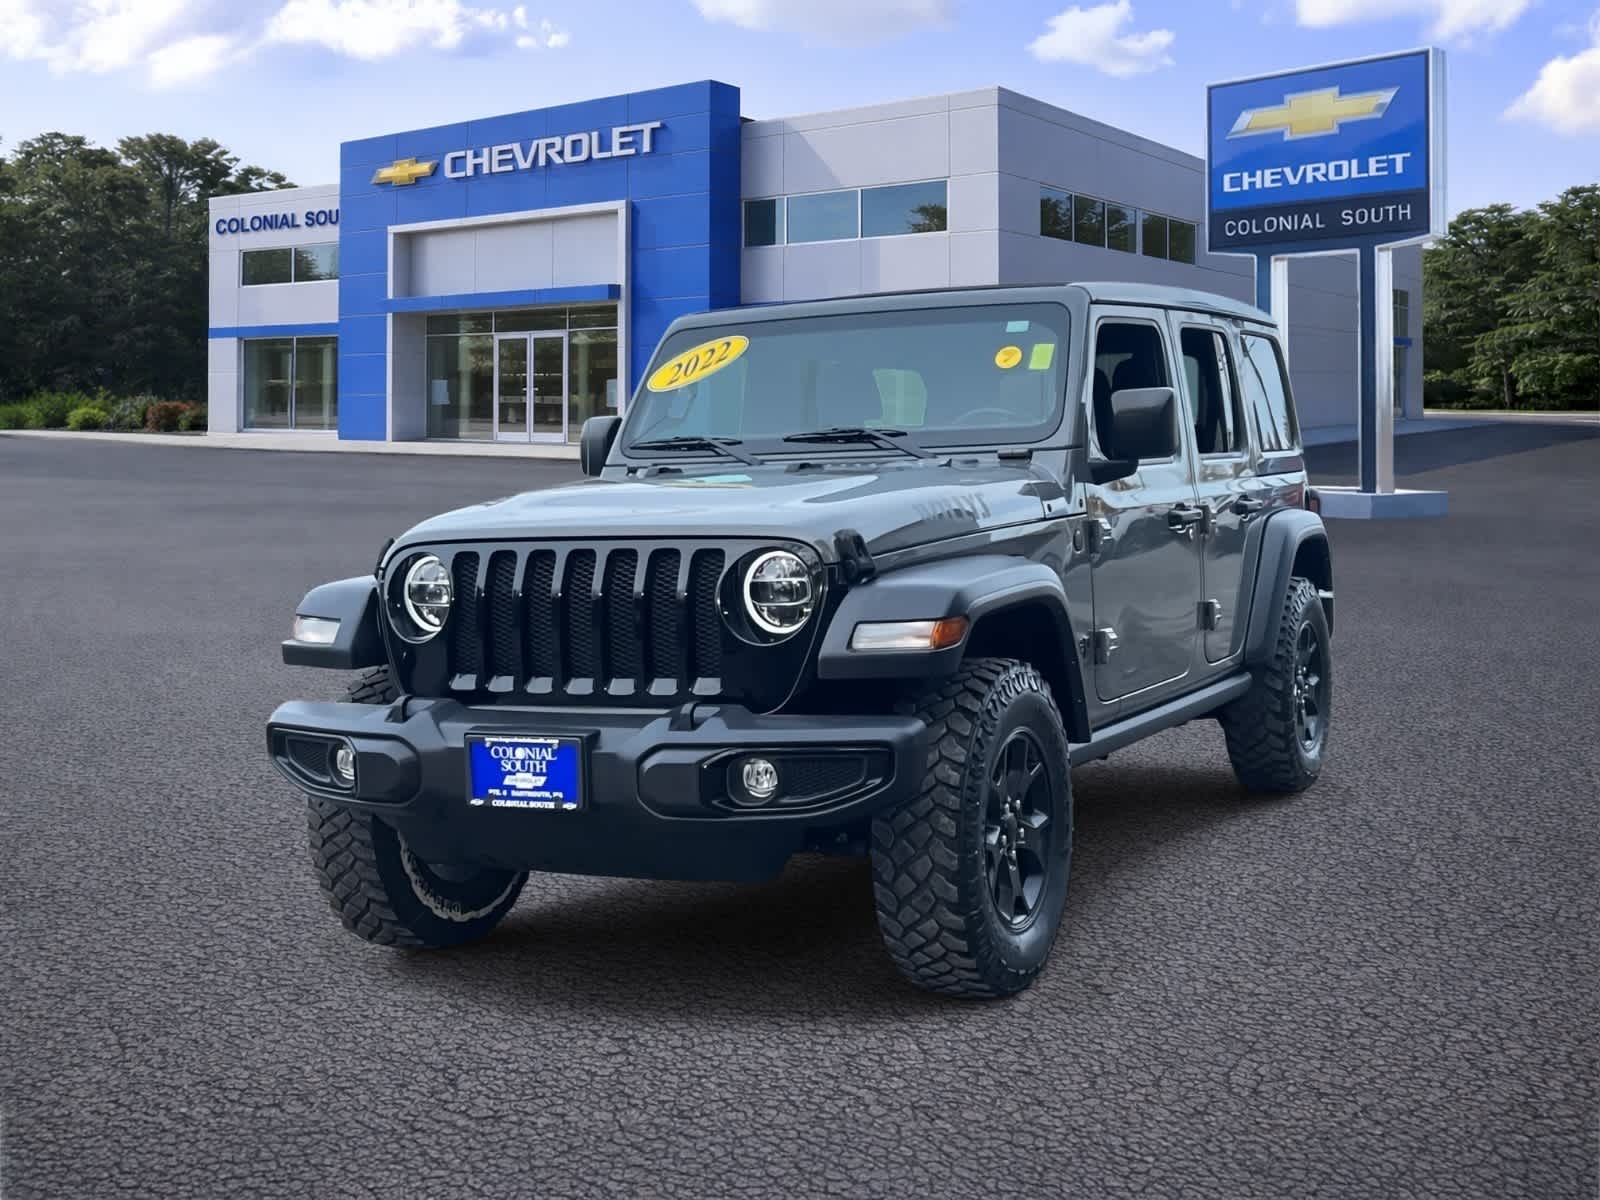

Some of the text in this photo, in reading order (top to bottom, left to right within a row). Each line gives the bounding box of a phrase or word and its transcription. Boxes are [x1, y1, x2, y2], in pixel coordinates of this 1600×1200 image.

[444, 121, 662, 179] CHEVROLET
[1223, 152, 1411, 192] CHEVROLET
[215, 208, 339, 235] COLONIAL SOU
[1225, 204, 1411, 236] COLONIAL SOUTH
[666, 341, 731, 385] 2022
[490, 746, 557, 760] COLONIAL
[501, 760, 546, 773] SOUTH
